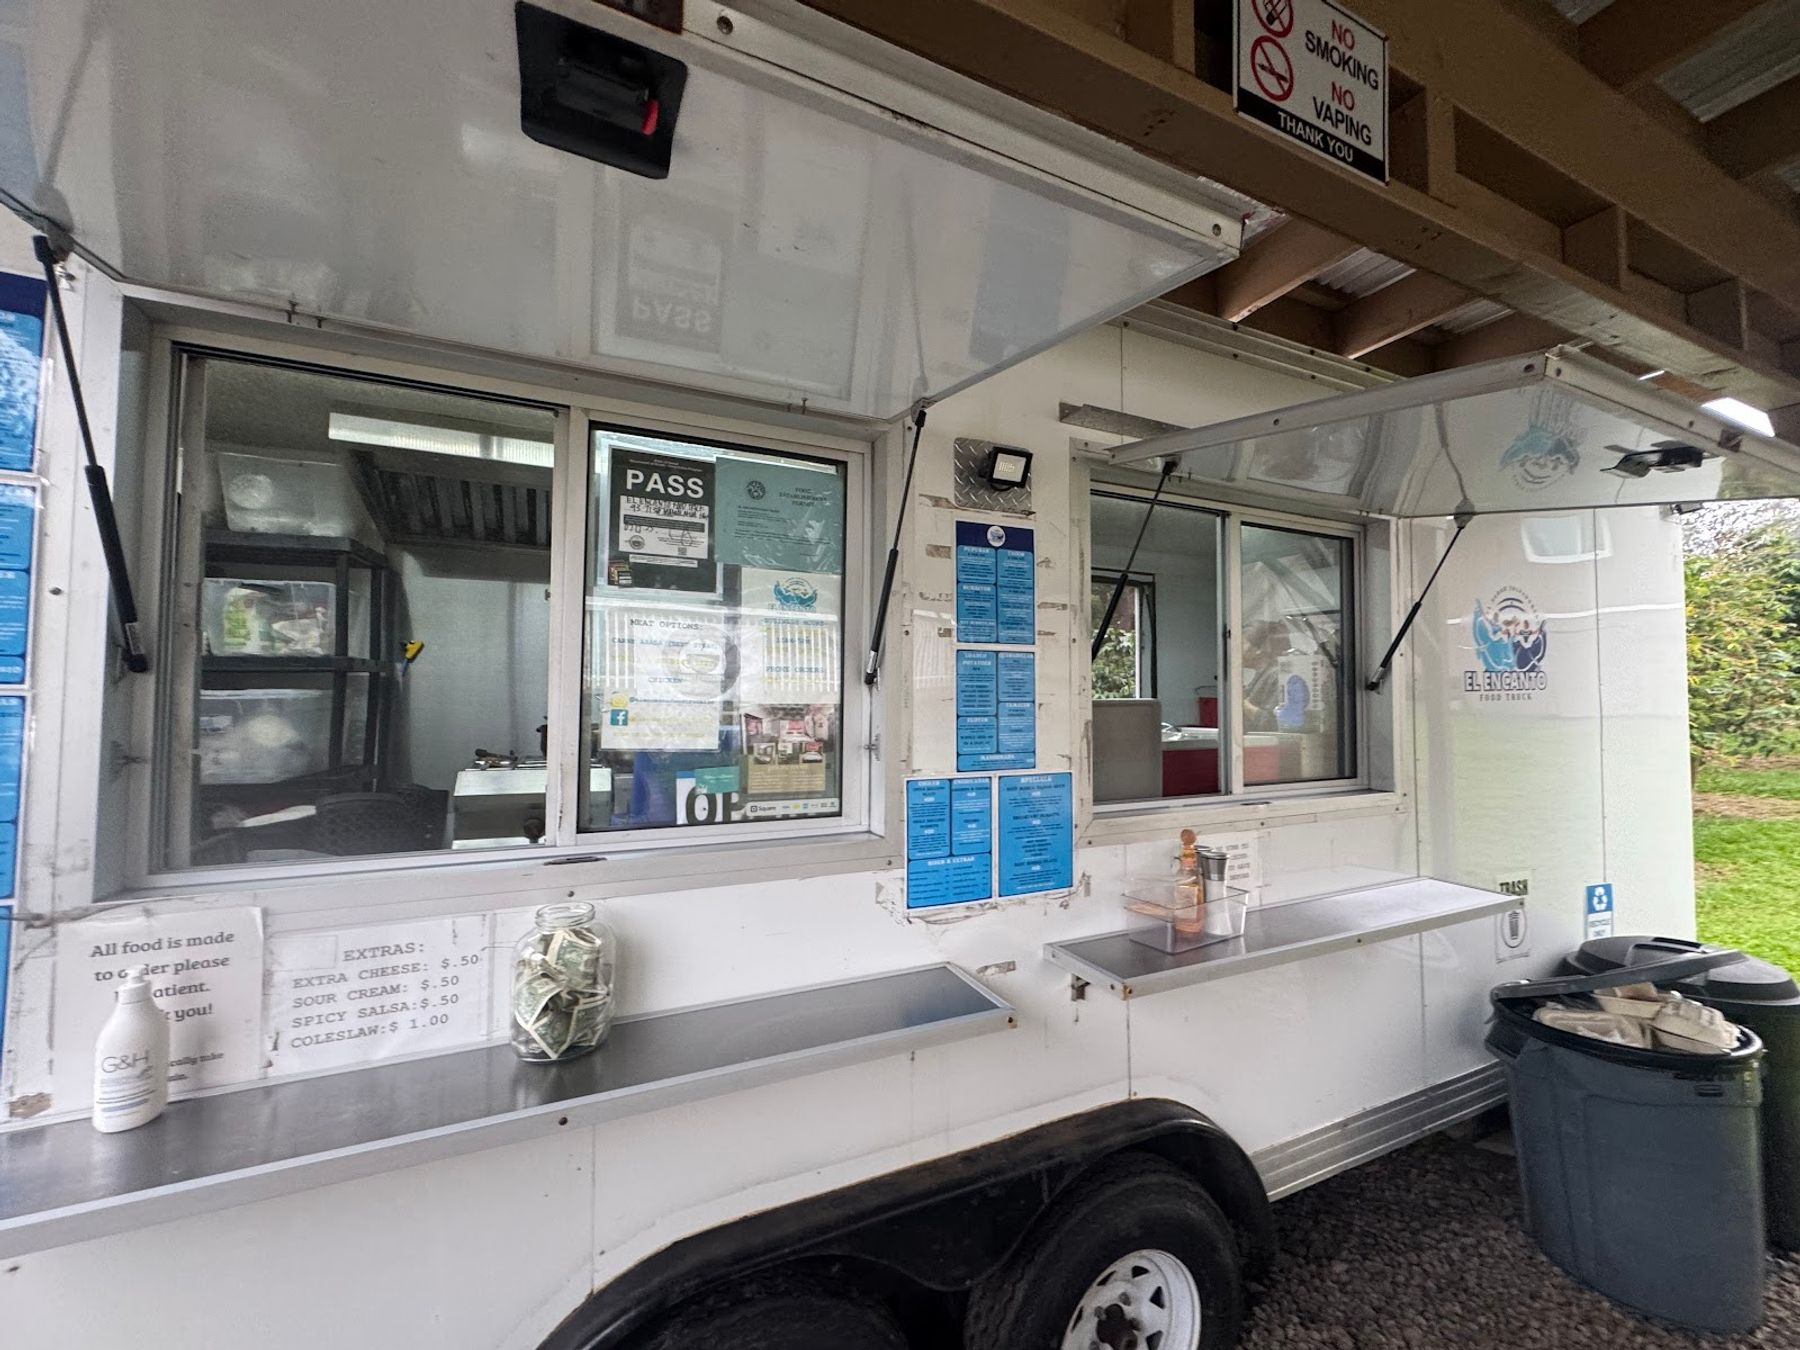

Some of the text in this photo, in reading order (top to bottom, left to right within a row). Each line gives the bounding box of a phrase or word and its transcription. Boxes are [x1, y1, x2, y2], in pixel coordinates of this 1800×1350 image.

[1332, 20, 1355, 50] NO
[1305, 30, 1378, 90] SMOKING
[1331, 82, 1355, 110] NO
[1313, 96, 1371, 145] VAPING
[1278, 111, 1353, 162] THANK YOU
[626, 469, 704, 498] PASS
[630, 618, 655, 627] MEAT
[1464, 671, 1547, 691] EL ENCANTO
[1498, 879, 1528, 896] TRASH
[89, 931, 235, 957] All food is made
[343, 943, 424, 961] EXTRAS:
[94, 970, 113, 981] to
[173, 957, 230, 975] please
[293, 954, 479, 988] EXTRA CHEESE: $.50
[153, 982, 210, 998] atient.
[293, 975, 459, 1008] SOUR CREAM: $.50
[174, 1003, 213, 1022] you!
[292, 1011, 346, 1028] SPICY
[410, 1014, 449, 1029] 1.00
[102, 1050, 149, 1073] G&H
